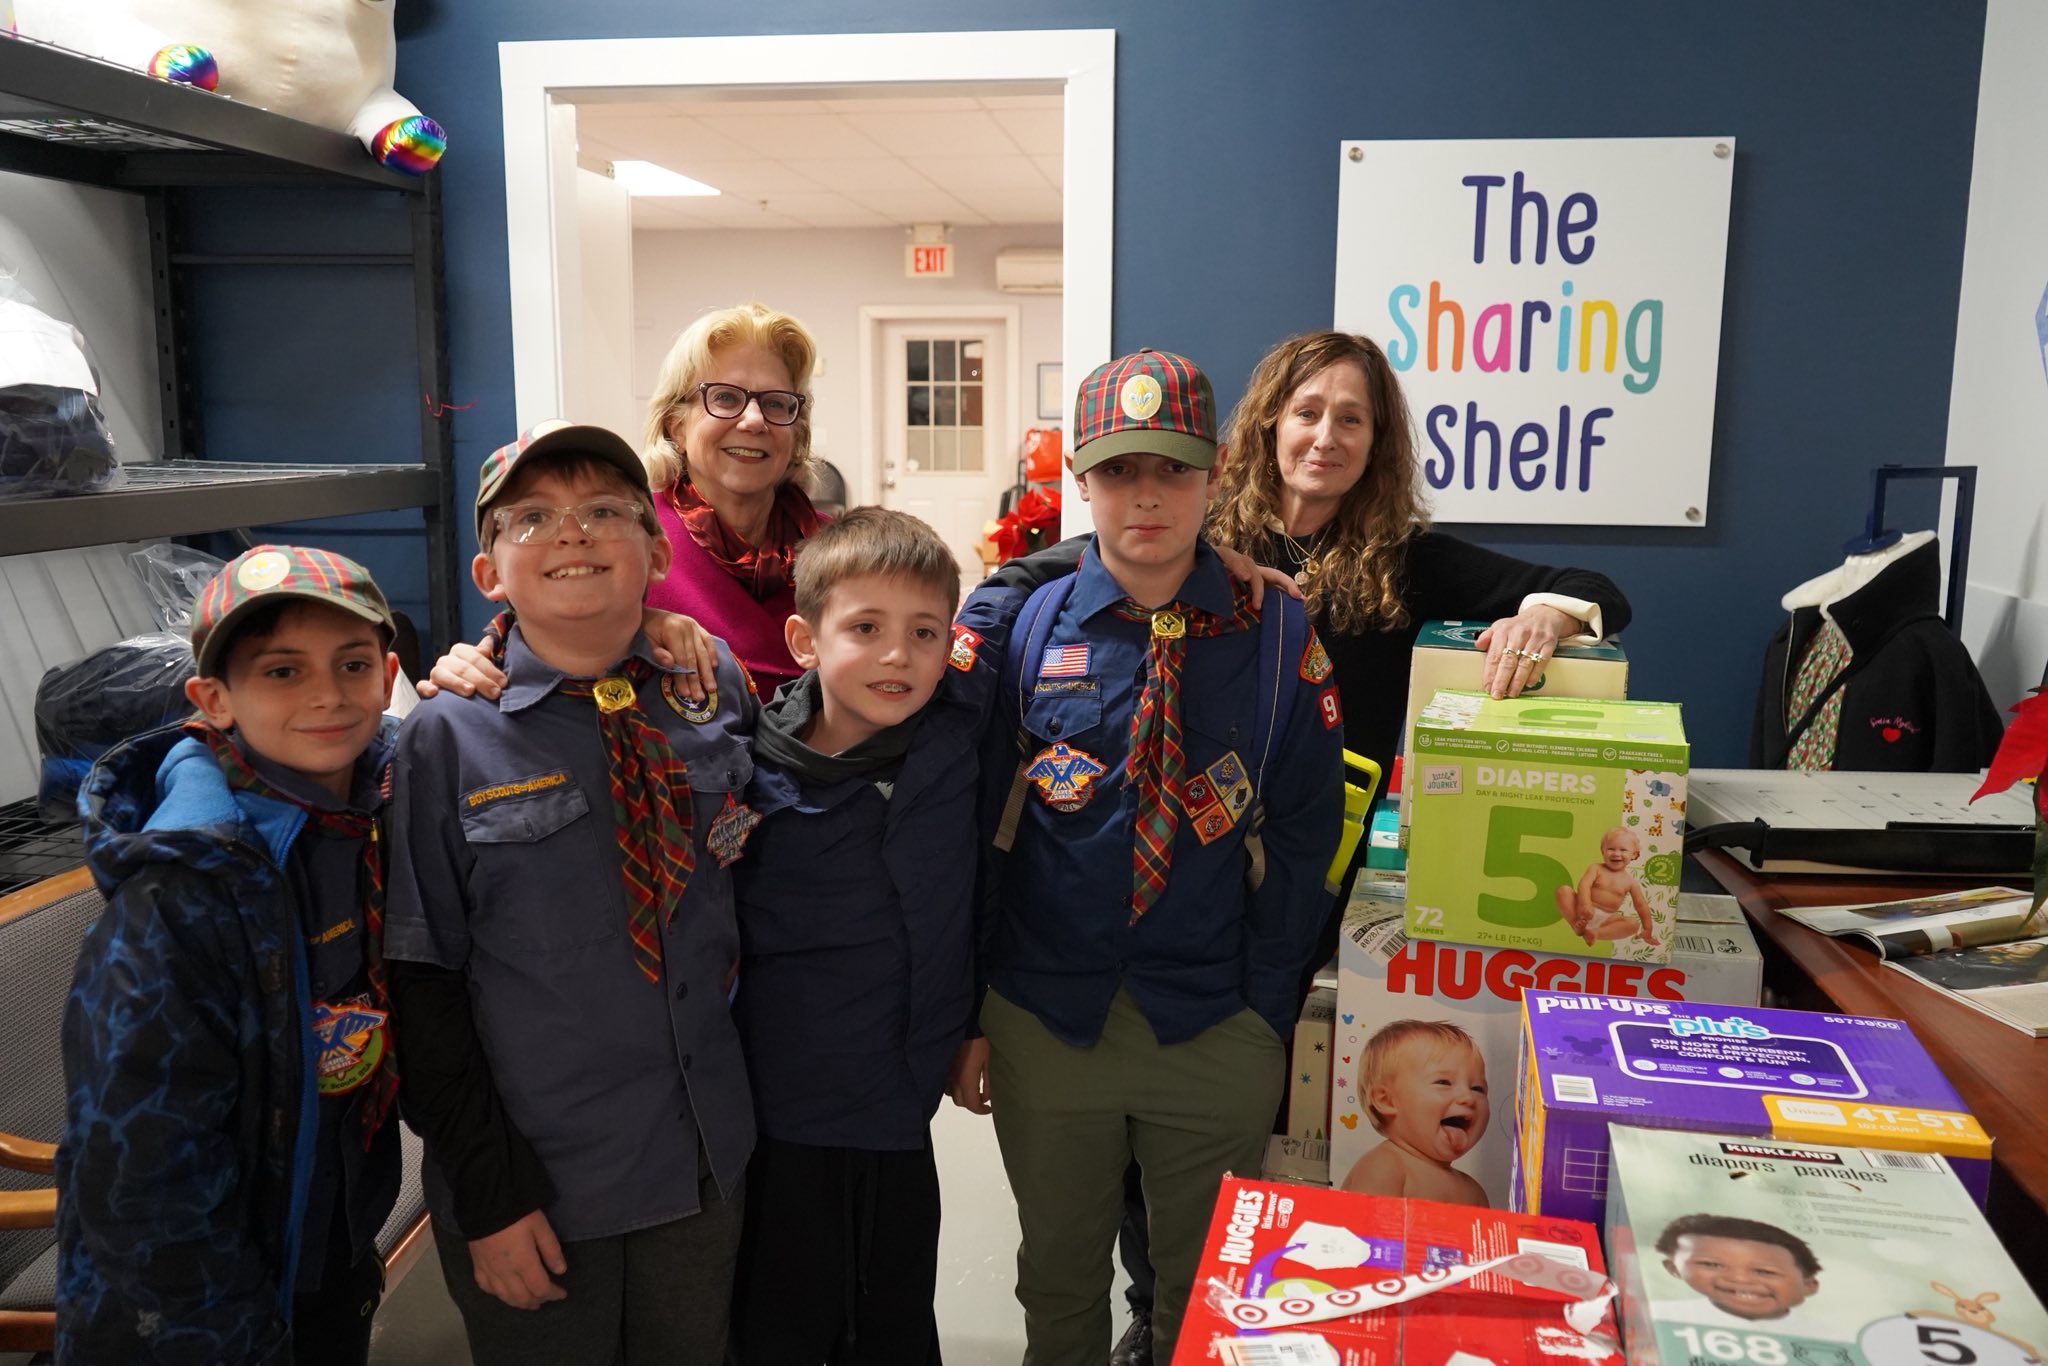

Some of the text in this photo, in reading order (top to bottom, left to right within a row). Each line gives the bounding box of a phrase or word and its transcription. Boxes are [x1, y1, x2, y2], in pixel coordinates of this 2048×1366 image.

[1462, 171, 1598, 265] The
[914, 247, 947, 273] EXIT
[1386, 280, 1664, 394] Sharing
[1425, 401, 1614, 492] Shelf
[1323, 695, 1337, 722] 9
[468, 792, 486, 806] BOY
[486, 785, 520, 800] SCOUTS
[528, 773, 567, 792] AMERICA
[1427, 780, 1457, 789] JOURNEY
[1477, 766, 1597, 795] DIAPERS
[1475, 789, 1492, 797] DAY
[1525, 793, 1543, 801] LEAK
[1545, 795, 1595, 806] PROTECTION
[1477, 804, 1575, 929] 5
[1655, 861, 1667, 877] 2
[1415, 905, 1444, 928] 72
[322, 918, 356, 944] AMERICA
[1413, 926, 1444, 936] DIAPERS
[1477, 931, 1493, 940] 27+
[1495, 934, 1507, 942] LB
[1387, 940, 1686, 1002] HUGGIES
[1536, 996, 1671, 1017] Pull-Ups
[1650, 1038, 1679, 1046] OUR
[1681, 1040, 1719, 1049] MOST
[1701, 1036, 1748, 1045] PROMISE
[1652, 1043, 1811, 1064] FOR MORE PROTECTION,
[1678, 1051, 1742, 1062] COMFORT
[1757, 1058, 1790, 1066] FUN!
[1786, 1106, 1837, 1117] Unisex
[1879, 1125, 1920, 1134] COUNT
[1689, 1153, 1776, 1173] diapers
[1726, 1143, 1836, 1161] KIRKLAND
[1218, 1190, 1265, 1265] HUGGIES
[1672, 1326, 1788, 1366] 168
[1917, 1324, 1977, 1366] 5
